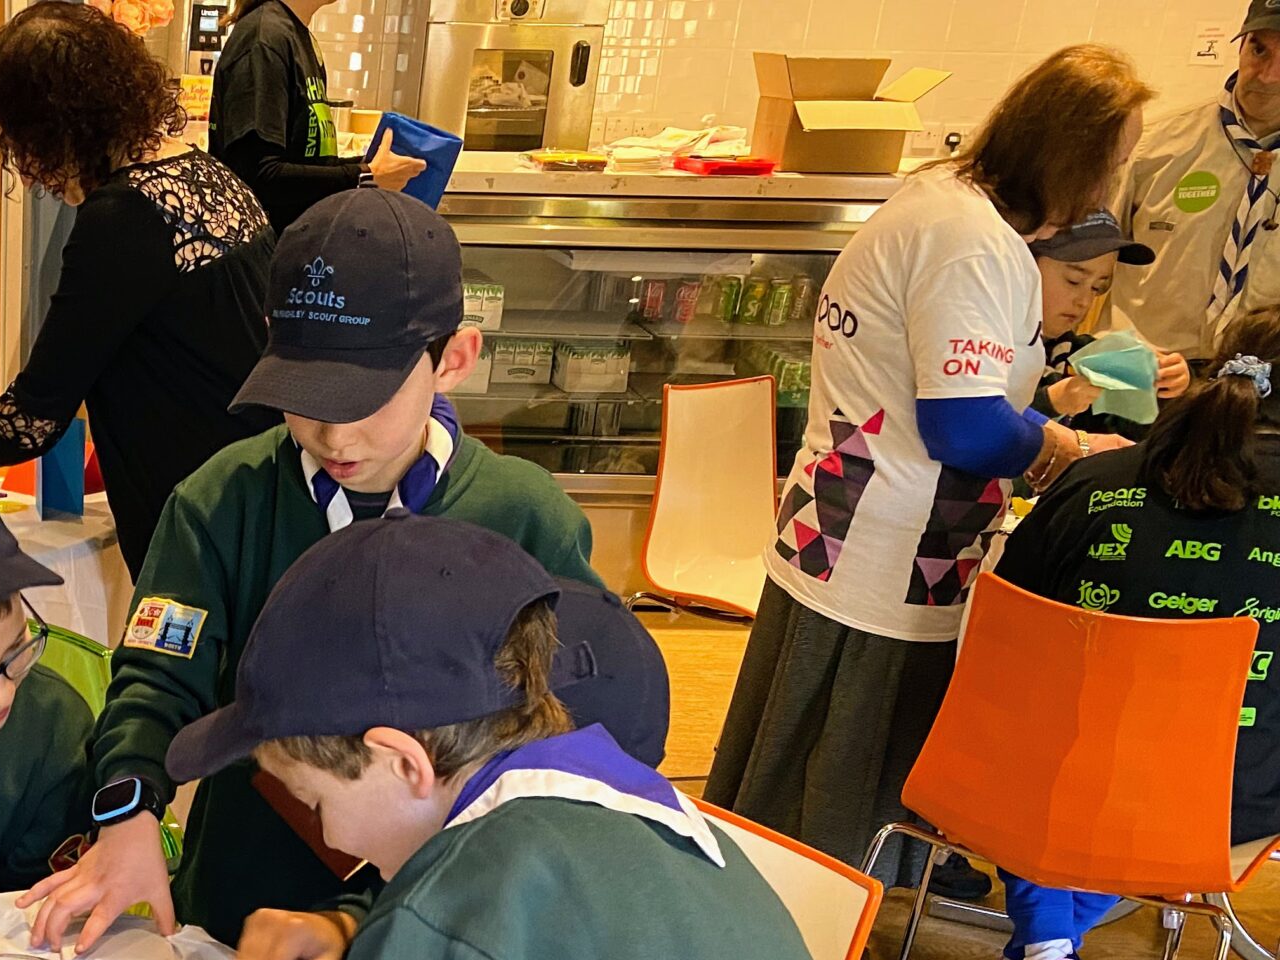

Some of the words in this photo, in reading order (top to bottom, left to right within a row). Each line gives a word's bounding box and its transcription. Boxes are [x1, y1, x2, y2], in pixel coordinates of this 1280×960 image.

[305, 105, 318, 157] EVERY
[287, 288, 346, 309] Scouts
[308, 311, 338, 323] SCOUT
[338, 315, 371, 326] GROUP
[948, 338, 1016, 365] TAKING
[942, 358, 981, 376] ON
[1087, 499, 1144, 515] Foundation
[1089, 487, 1148, 507] Pears
[1087, 543, 1128, 557] AJEX
[1164, 539, 1222, 561] ABG
[1148, 592, 1219, 615] Geiger
